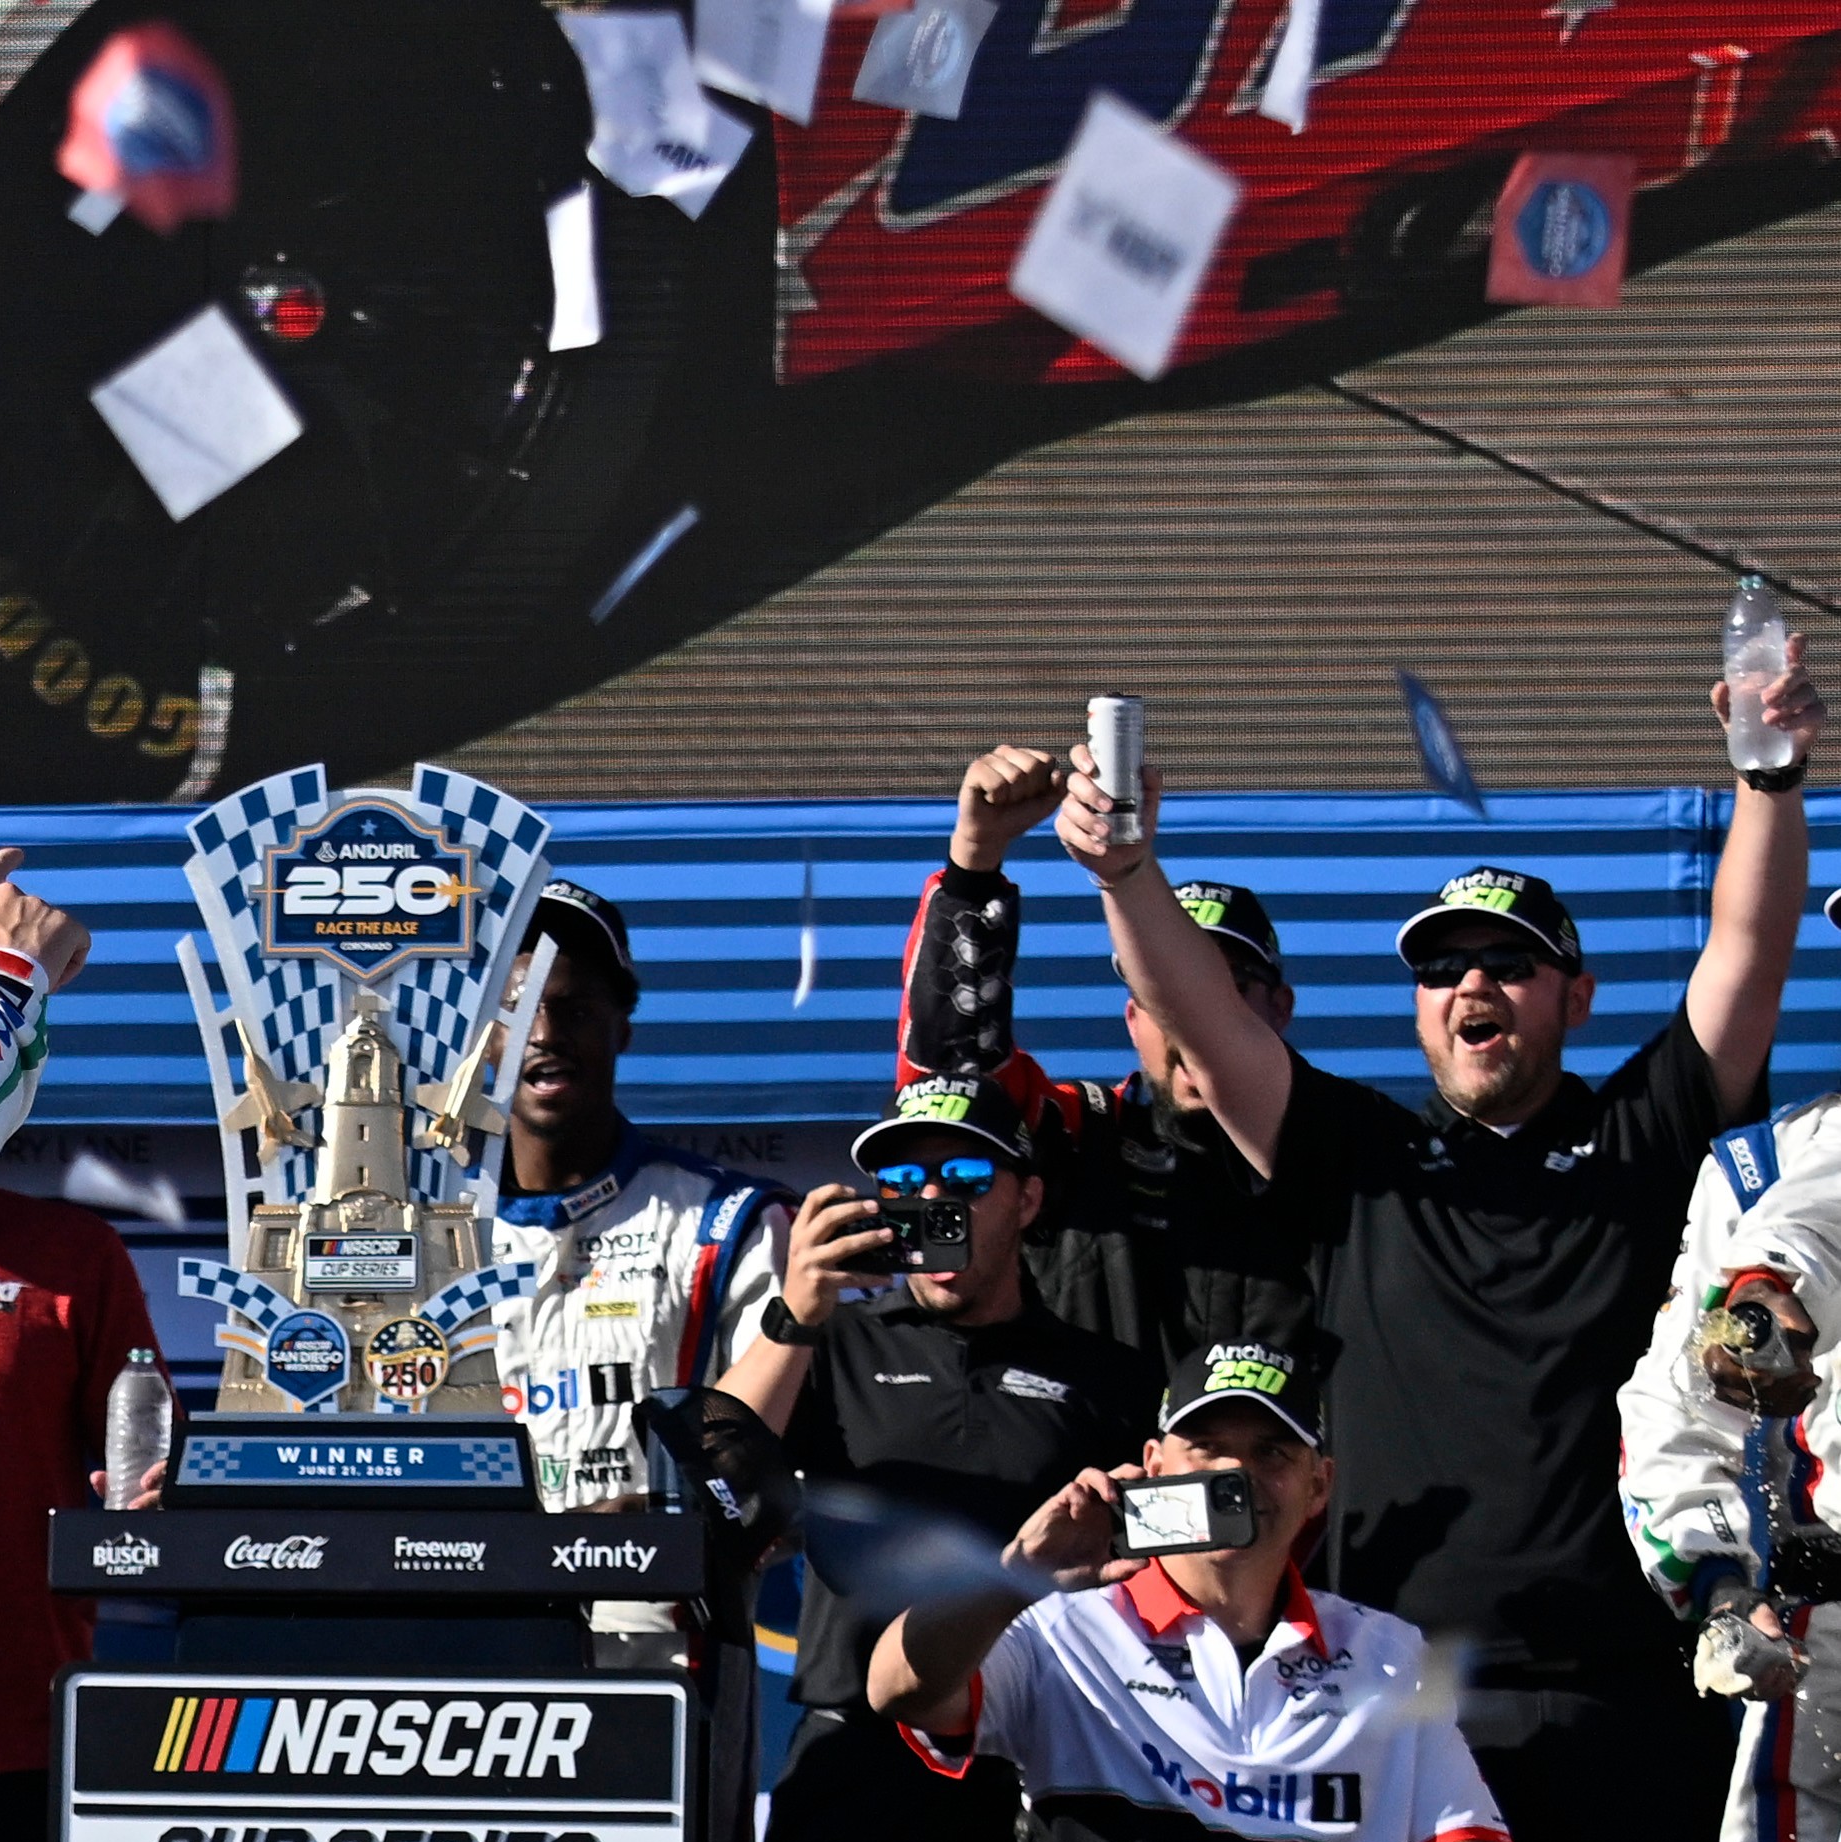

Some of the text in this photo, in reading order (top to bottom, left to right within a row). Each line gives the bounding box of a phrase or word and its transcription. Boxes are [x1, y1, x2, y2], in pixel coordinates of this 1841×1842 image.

[339, 844, 421, 860] ANDURIL
[283, 866, 453, 915] 250
[315, 920, 420, 936] RACE THE BASE
[340, 941, 394, 951] CORONADO
[320, 1262, 401, 1277] CUP SERIES
[269, 1350, 344, 1365] SAN DIEGO
[380, 1362, 437, 1388] 250
[1203, 1360, 1288, 1396] 250
[501, 1368, 579, 1415] obil
[276, 1446, 426, 1465] WINNER
[297, 1465, 403, 1478] JUNE 21, 2026
[92, 1544, 161, 1568] BUSCH
[395, 1535, 487, 1563] Freeway
[550, 1537, 658, 1574] xfinity
[394, 1562, 486, 1572] INSURANCE
[259, 1696, 594, 1779] NASCAR
[1141, 1742, 1298, 1824] Mobil
